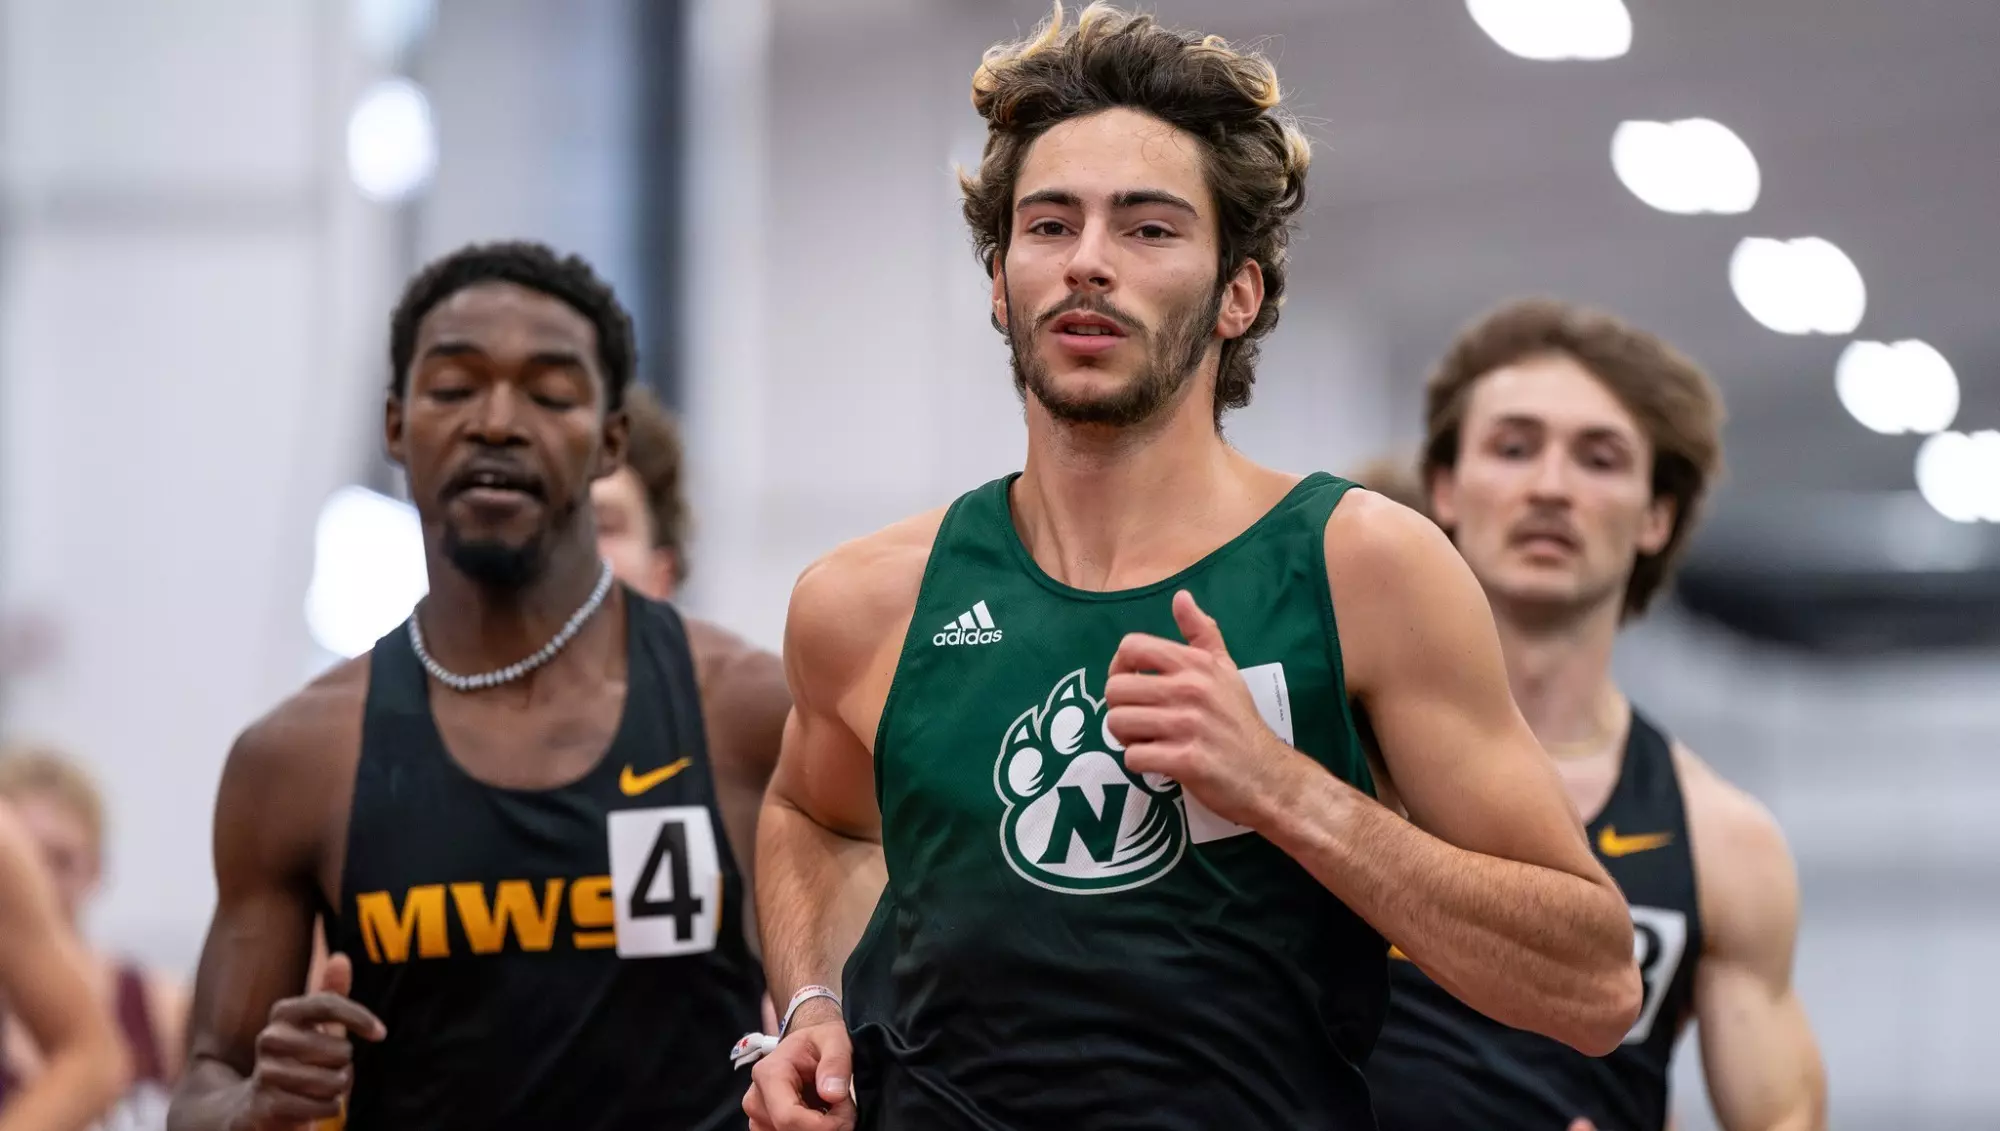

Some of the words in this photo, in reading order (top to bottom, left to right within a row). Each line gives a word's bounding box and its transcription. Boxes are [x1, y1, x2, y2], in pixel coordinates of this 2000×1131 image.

[932, 628, 1003, 647] adidas
[1036, 783, 1131, 865] N
[355, 875, 722, 964] MWS
[628, 819, 704, 943] 4
